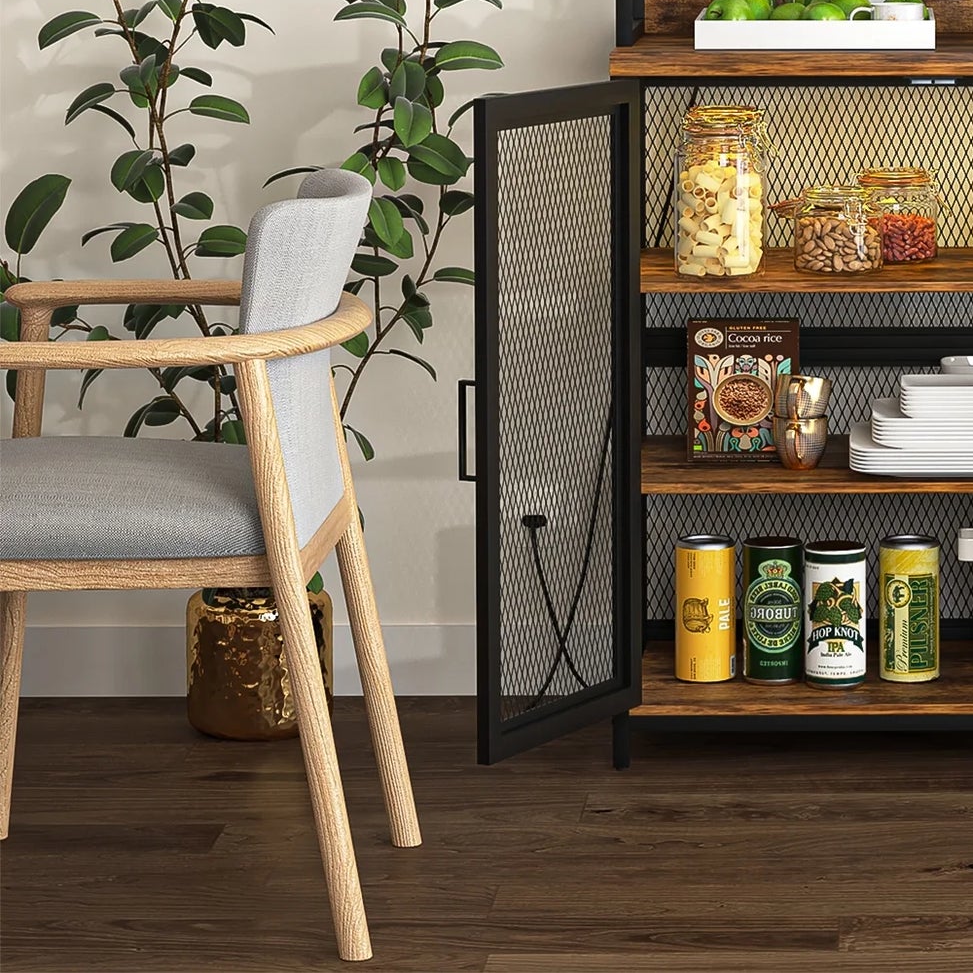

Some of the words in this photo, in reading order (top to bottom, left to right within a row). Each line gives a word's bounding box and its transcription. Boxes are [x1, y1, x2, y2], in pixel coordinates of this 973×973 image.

[728, 333, 760, 343] Cocoa
[763, 333, 783, 343] rice
[718, 598, 731, 631] PALE
[910, 579, 929, 669] PILSNER
[812, 627, 832, 641] HOP
[834, 627, 859, 640] KNOT
[896, 619, 910, 672] Premium
[827, 641, 845, 652] IPA
